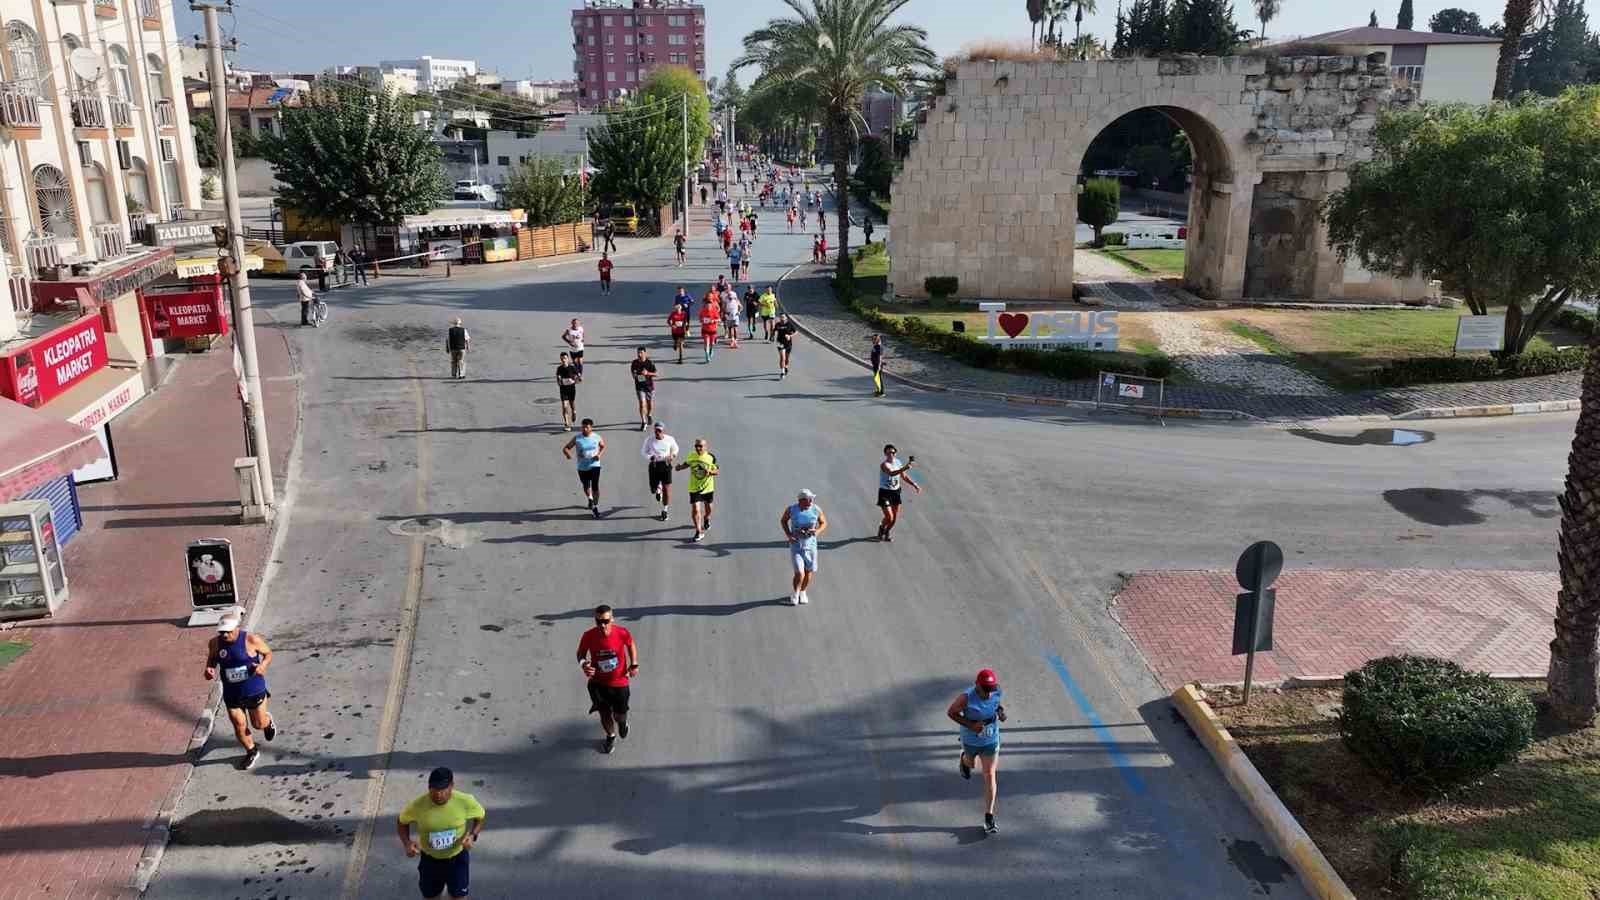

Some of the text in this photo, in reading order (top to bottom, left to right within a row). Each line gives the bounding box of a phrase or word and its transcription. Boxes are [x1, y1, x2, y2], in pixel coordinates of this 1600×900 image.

[158, 226, 187, 240] TATLI
[169, 304, 212, 316] KLEOPATRA
[177, 315, 208, 326] MARKET
[43, 328, 97, 368] KLEOPATRA
[56, 351, 93, 386] MARKET
